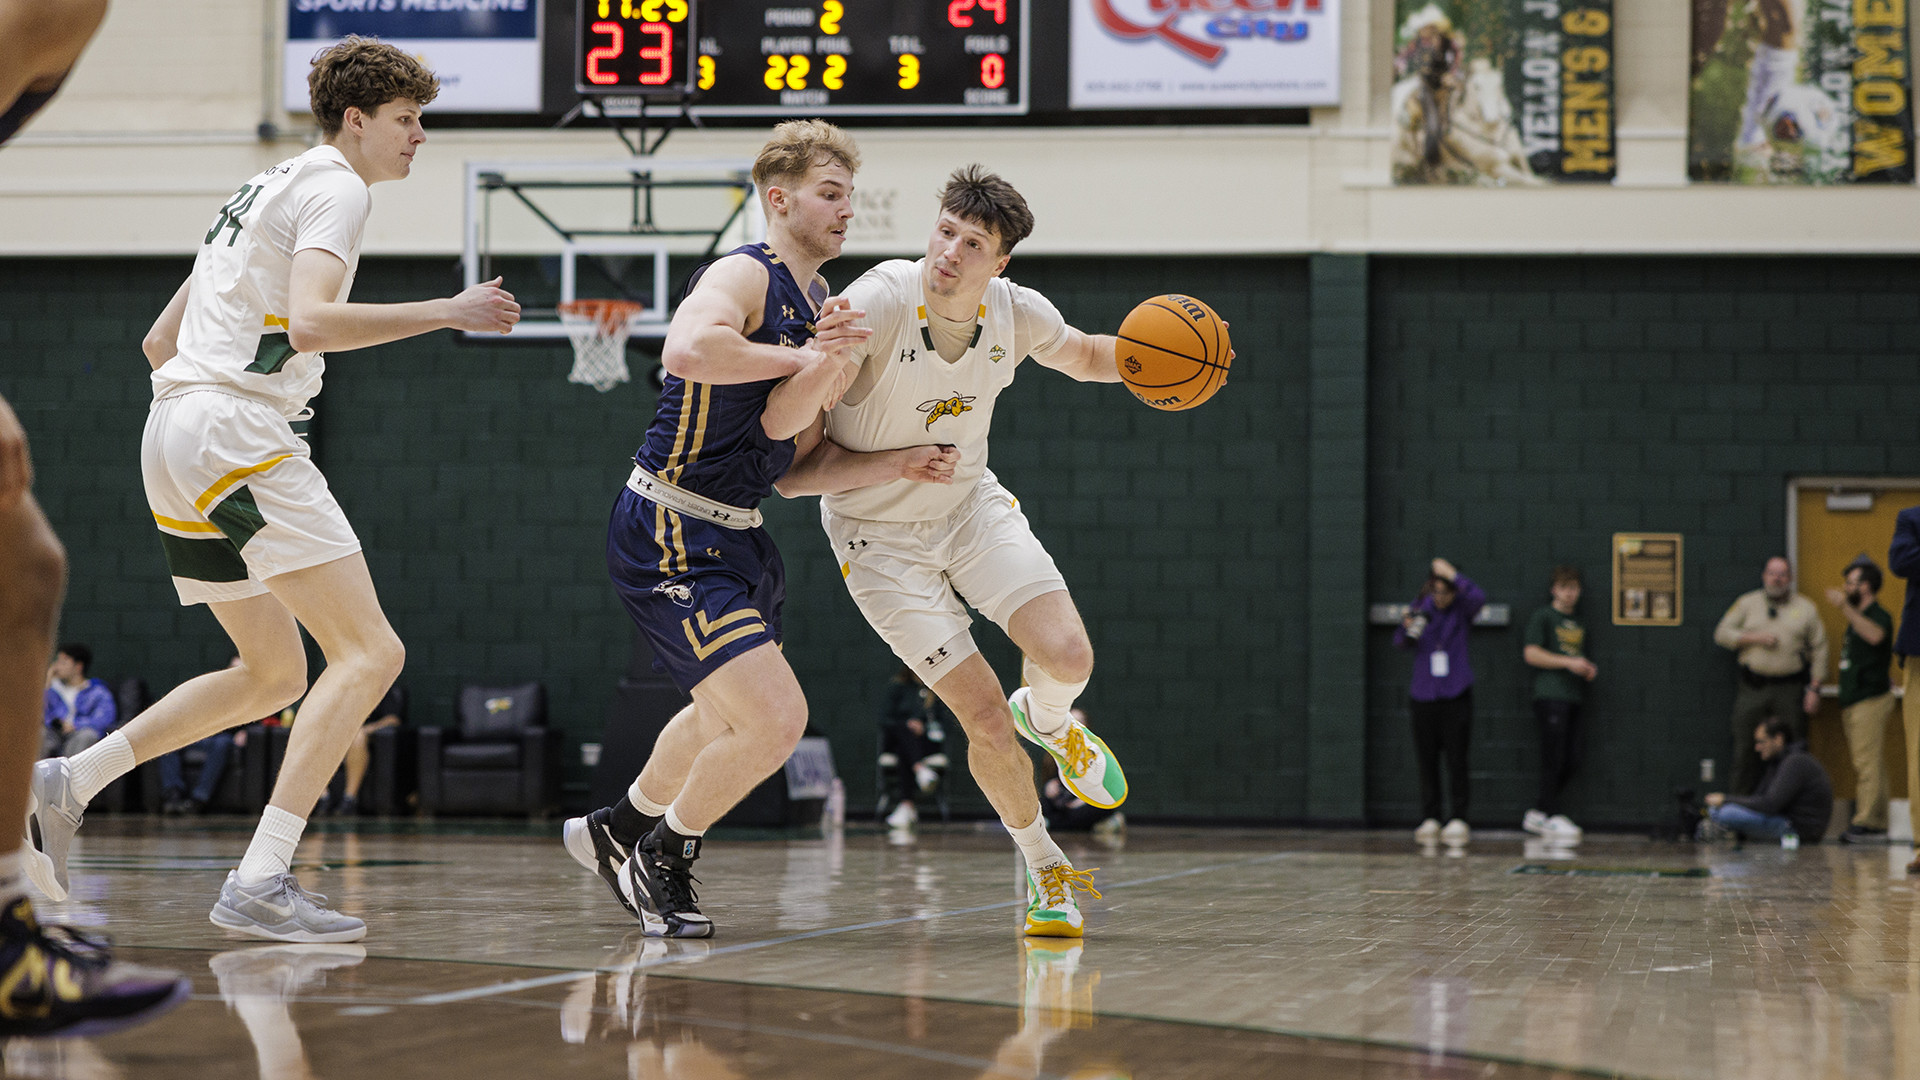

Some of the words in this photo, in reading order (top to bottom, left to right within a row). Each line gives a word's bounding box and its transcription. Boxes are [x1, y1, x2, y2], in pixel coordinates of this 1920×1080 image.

[820, 0, 845, 35] 2
[1561, 8, 1610, 37] &
[586, 21, 673, 85] 23
[980, 53, 1005, 89] 0
[698, 55, 716, 90] 3
[764, 54, 810, 90] 22
[823, 54, 847, 90] 2
[898, 53, 920, 90] 3
[1561, 46, 1610, 173] MEN'S
[204, 183, 264, 247] 34
